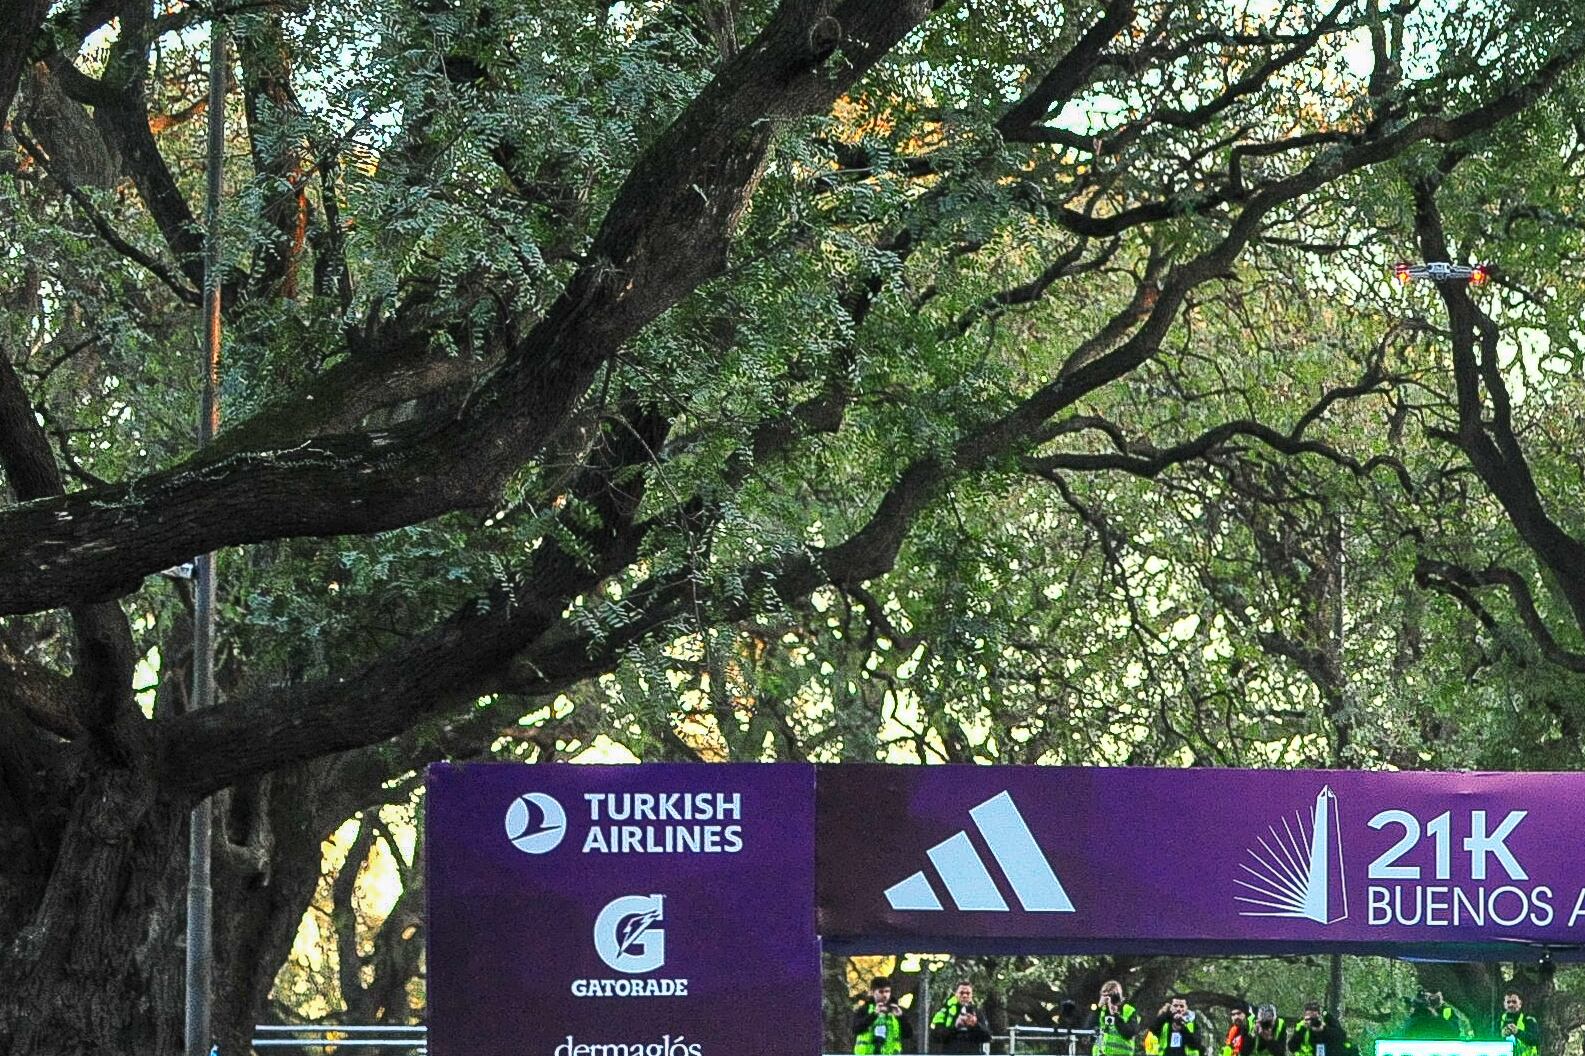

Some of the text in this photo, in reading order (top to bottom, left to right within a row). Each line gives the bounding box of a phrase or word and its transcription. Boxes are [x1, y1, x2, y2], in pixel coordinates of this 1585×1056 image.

[584, 793, 741, 820] TURKISH
[582, 826, 743, 853] AIRLINES
[1368, 810, 1528, 880] 21K
[1369, 886, 1554, 926] BUENOS
[571, 979, 688, 997] GATORADE
